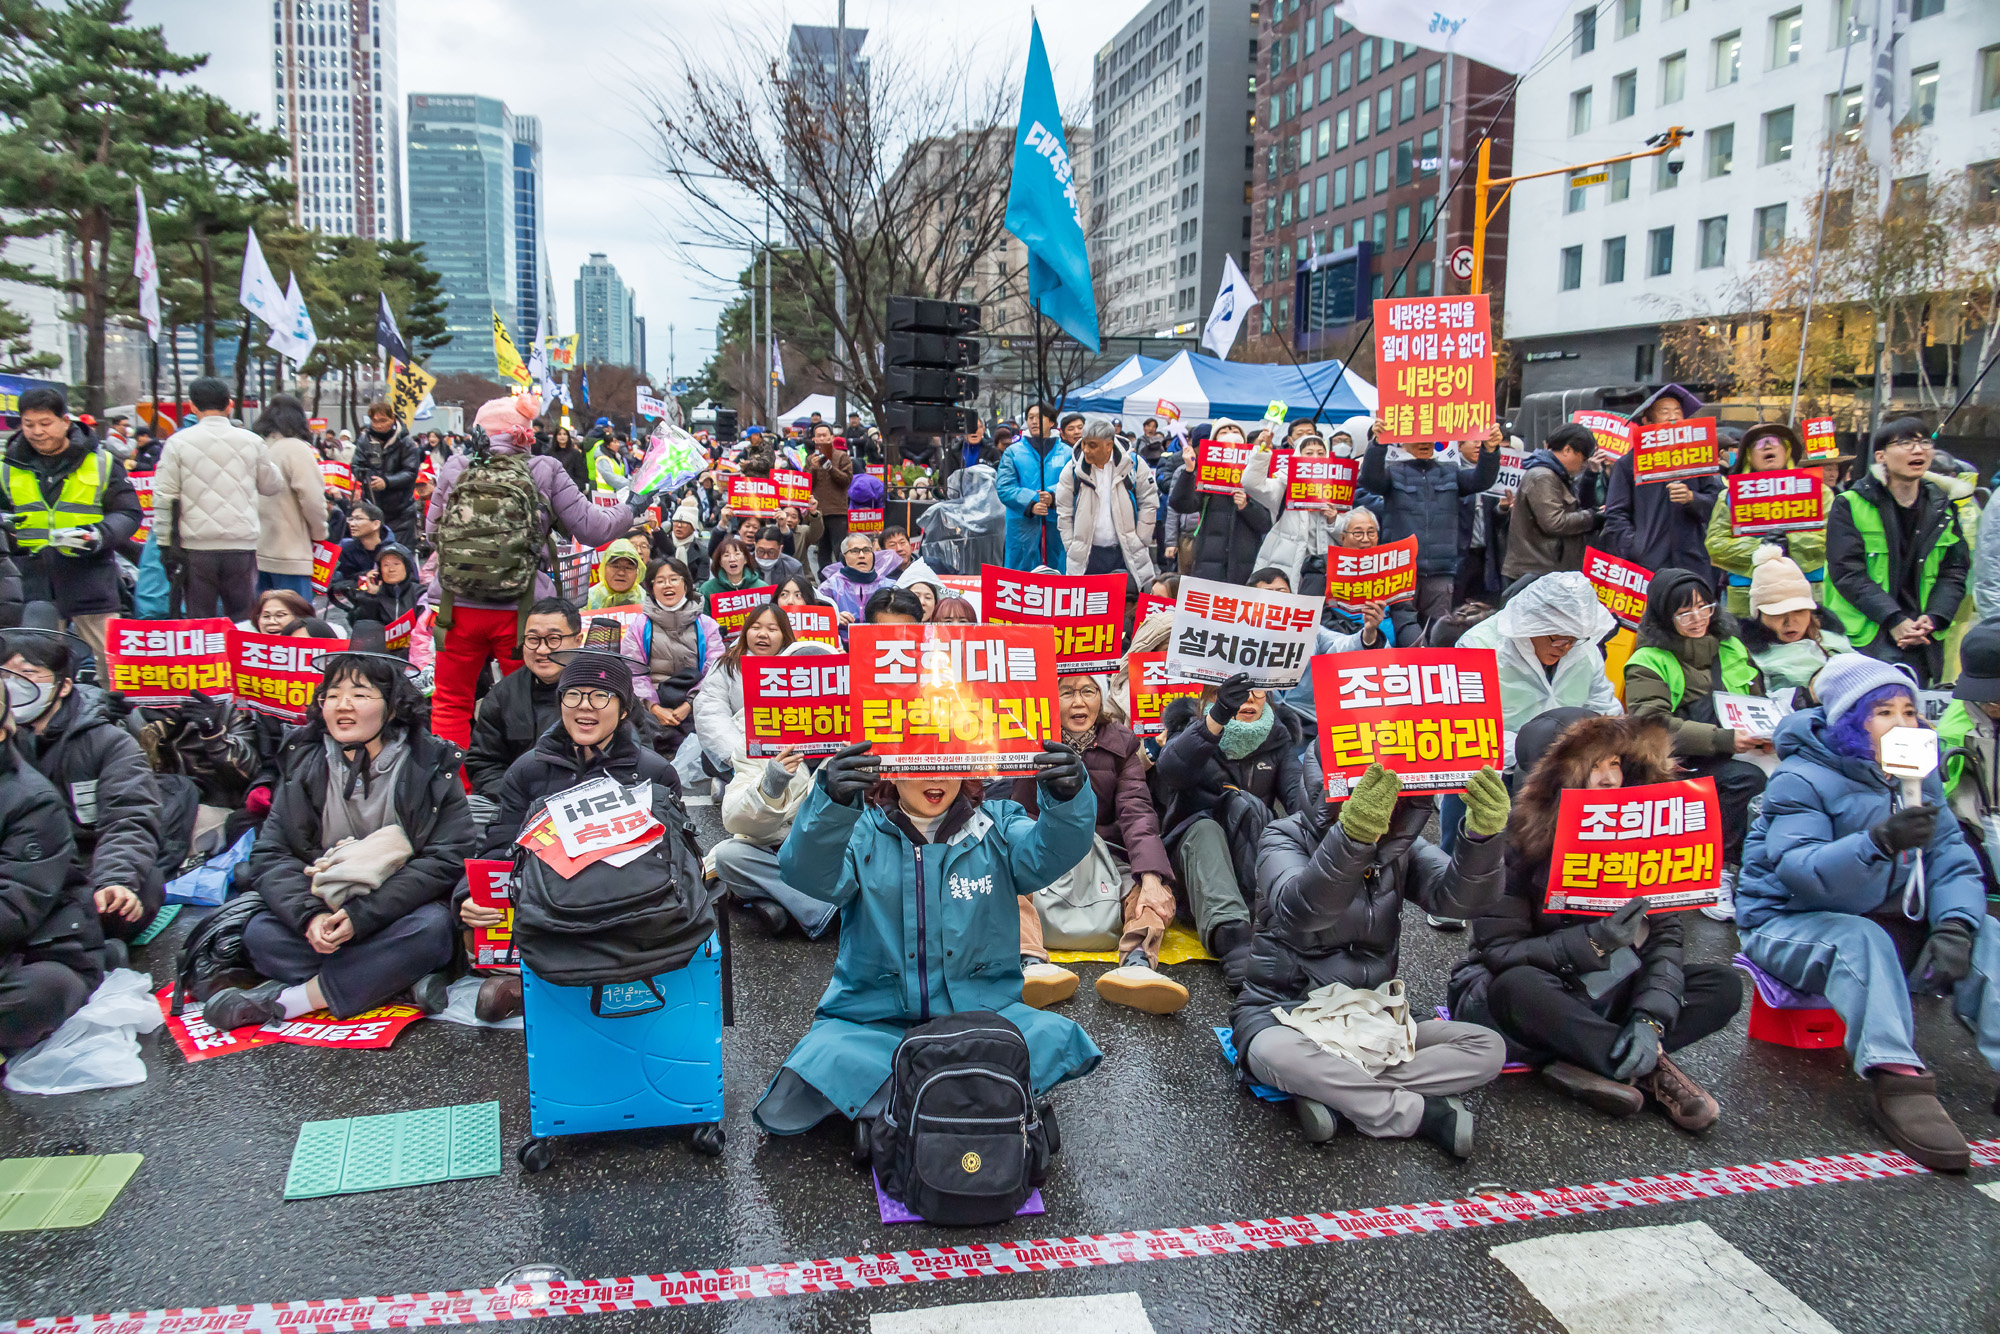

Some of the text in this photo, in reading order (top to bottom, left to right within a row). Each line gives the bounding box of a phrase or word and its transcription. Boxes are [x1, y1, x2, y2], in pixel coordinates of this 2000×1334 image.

[1389, 301, 1475, 331] 내란당은 국민을
[1382, 331, 1486, 362] 절대 이길 수 없다
[1397, 364, 1473, 398] 내란당이
[1384, 400, 1491, 436] 퇴출 될 때까지!
[1579, 415, 1630, 438] 조희대를
[1596, 434, 1630, 455] 하라!
[1641, 425, 1707, 449] 조희대를
[1207, 446, 1250, 464] 조희대
[1637, 446, 1713, 472] 탄핵하라!
[774, 472, 809, 487] 조희대를
[1201, 466, 1242, 484] 탄핵하
[1296, 463, 1352, 480] 조희대를
[730, 496, 778, 509] 탄핵하라!
[734, 481, 775, 495] 조희대를
[779, 487, 811, 501] 핵하라!
[1291, 483, 1353, 502] 탄핵하라!
[1737, 477, 1813, 499] 조희대를
[1735, 499, 1818, 523] 탄핵하라!
[1337, 549, 1410, 577] 조희대를
[996, 579, 1109, 617] 조희대를
[1330, 569, 1413, 600] 탄핵하라!
[717, 592, 772, 613] 조희대를
[1184, 589, 1315, 633] 특별재판부
[119, 629, 226, 656] 조희대를
[241, 640, 326, 674] 조희대
[1178, 626, 1305, 670] 설치하라!
[874, 638, 1037, 684] 조희대를
[114, 662, 231, 691] 탄핵하라!
[236, 673, 314, 707] 탄핵하
[759, 665, 850, 698] 조희대
[1338, 664, 1485, 709] 조희대를
[752, 705, 850, 738] 탄핵하
[862, 697, 1052, 744] 탄핵하라!
[1331, 718, 1499, 767] 탄핵하라!
[1578, 796, 1706, 840] 조희대를
[1561, 843, 1714, 889] 탄핵하라!
[949, 872, 993, 900] 촛불행동
[156, 1312, 252, 1333] 안전제일
[275, 1305, 374, 1326] DANGER!
[429, 1294, 472, 1315] 위험
[485, 1292, 533, 1312] 危險
[548, 1284, 634, 1305] 안전제일
[661, 1275, 751, 1297] DANGER!
[802, 1266, 843, 1283] 위험
[857, 1260, 900, 1279] 危險
[912, 1251, 992, 1272] 안전제일
[1015, 1243, 1099, 1263] DANGER!
[1145, 1236, 1184, 1253] 위험
[1195, 1231, 1237, 1248] 危險
[1244, 1221, 1317, 1243] 안전제일
[1335, 1213, 1414, 1232] DANGER!
[1453, 1203, 1488, 1219] 위험
[1498, 1198, 1536, 1215] 危險
[1542, 1189, 1602, 1209] 안전제일
[1626, 1179, 1693, 1198] DANGER!
[1726, 1170, 1758, 1185] 위험
[1805, 1158, 1864, 1178] 안전제일
